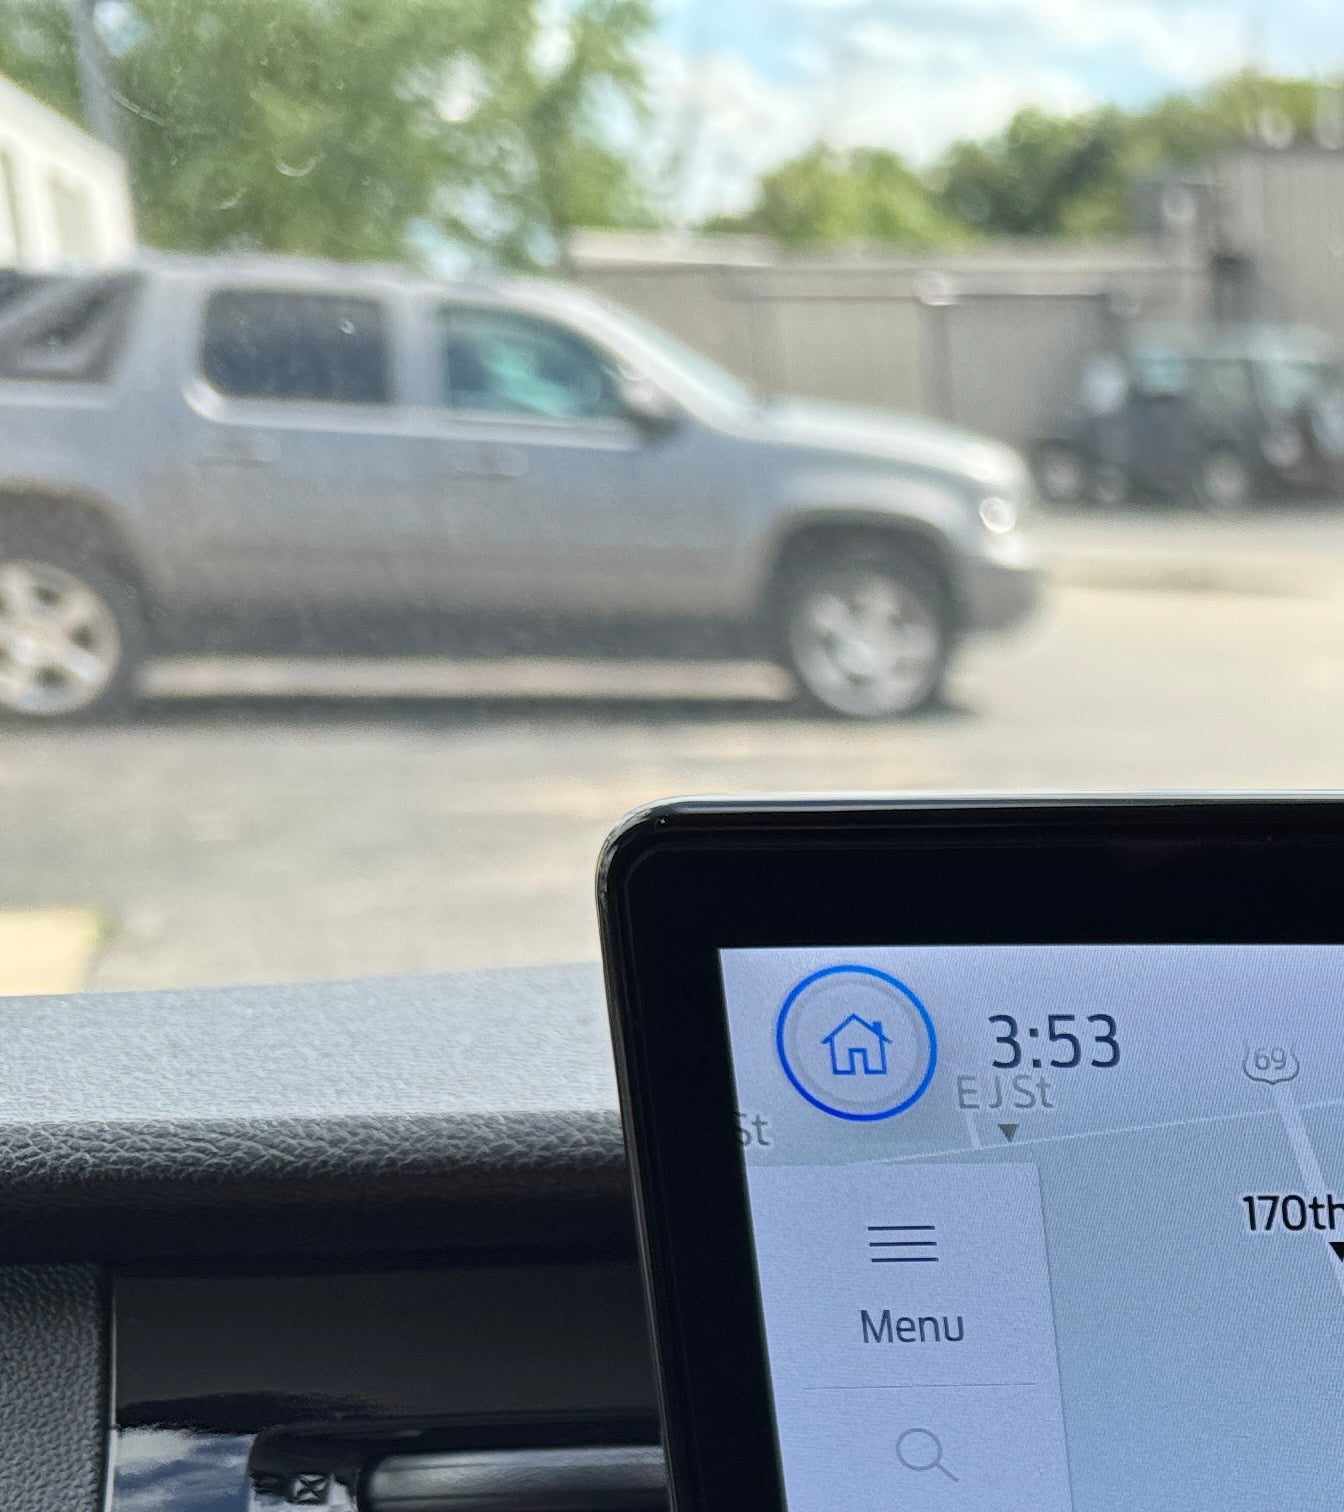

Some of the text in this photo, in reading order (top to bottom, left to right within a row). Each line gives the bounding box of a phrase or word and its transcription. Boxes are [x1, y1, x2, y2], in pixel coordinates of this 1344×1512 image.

[987, 1013, 1121, 1069] 3:53
[1253, 1048, 1287, 1072] 69
[956, 1076, 981, 1110] E
[1014, 1075, 1055, 1109] St
[859, 1309, 965, 1344] Menu
